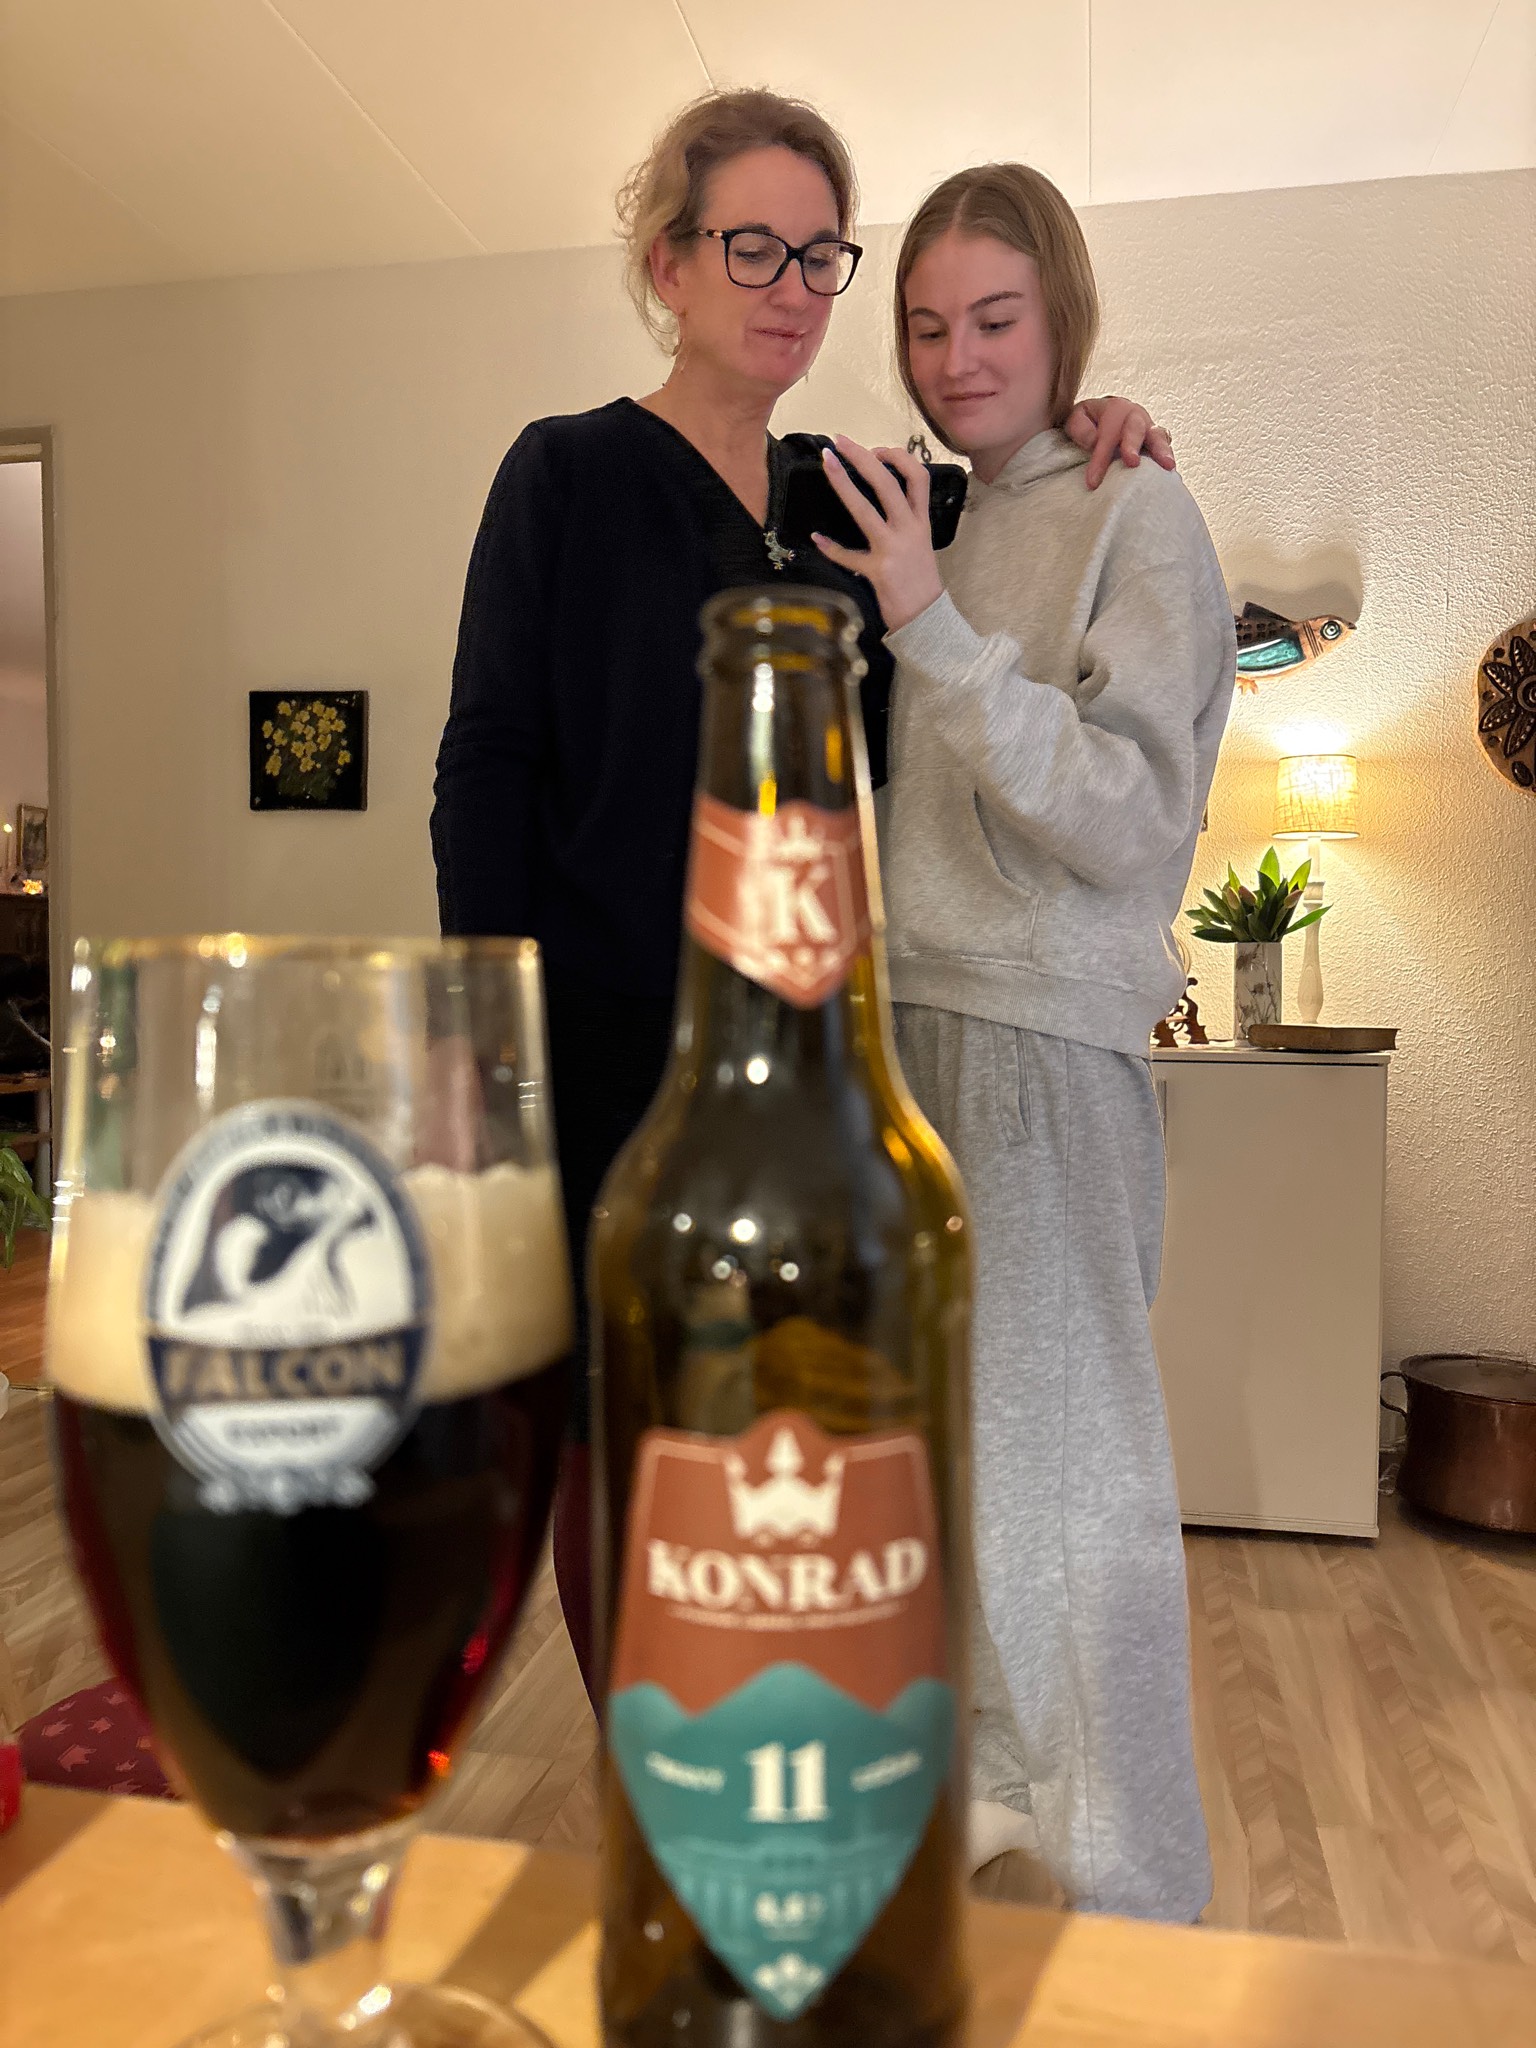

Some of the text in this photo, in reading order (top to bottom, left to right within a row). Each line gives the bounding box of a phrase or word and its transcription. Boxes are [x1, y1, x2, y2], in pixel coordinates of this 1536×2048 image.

[770, 861, 839, 944] K
[647, 1537, 928, 1612] KONRAD
[743, 1739, 831, 1823] 11
